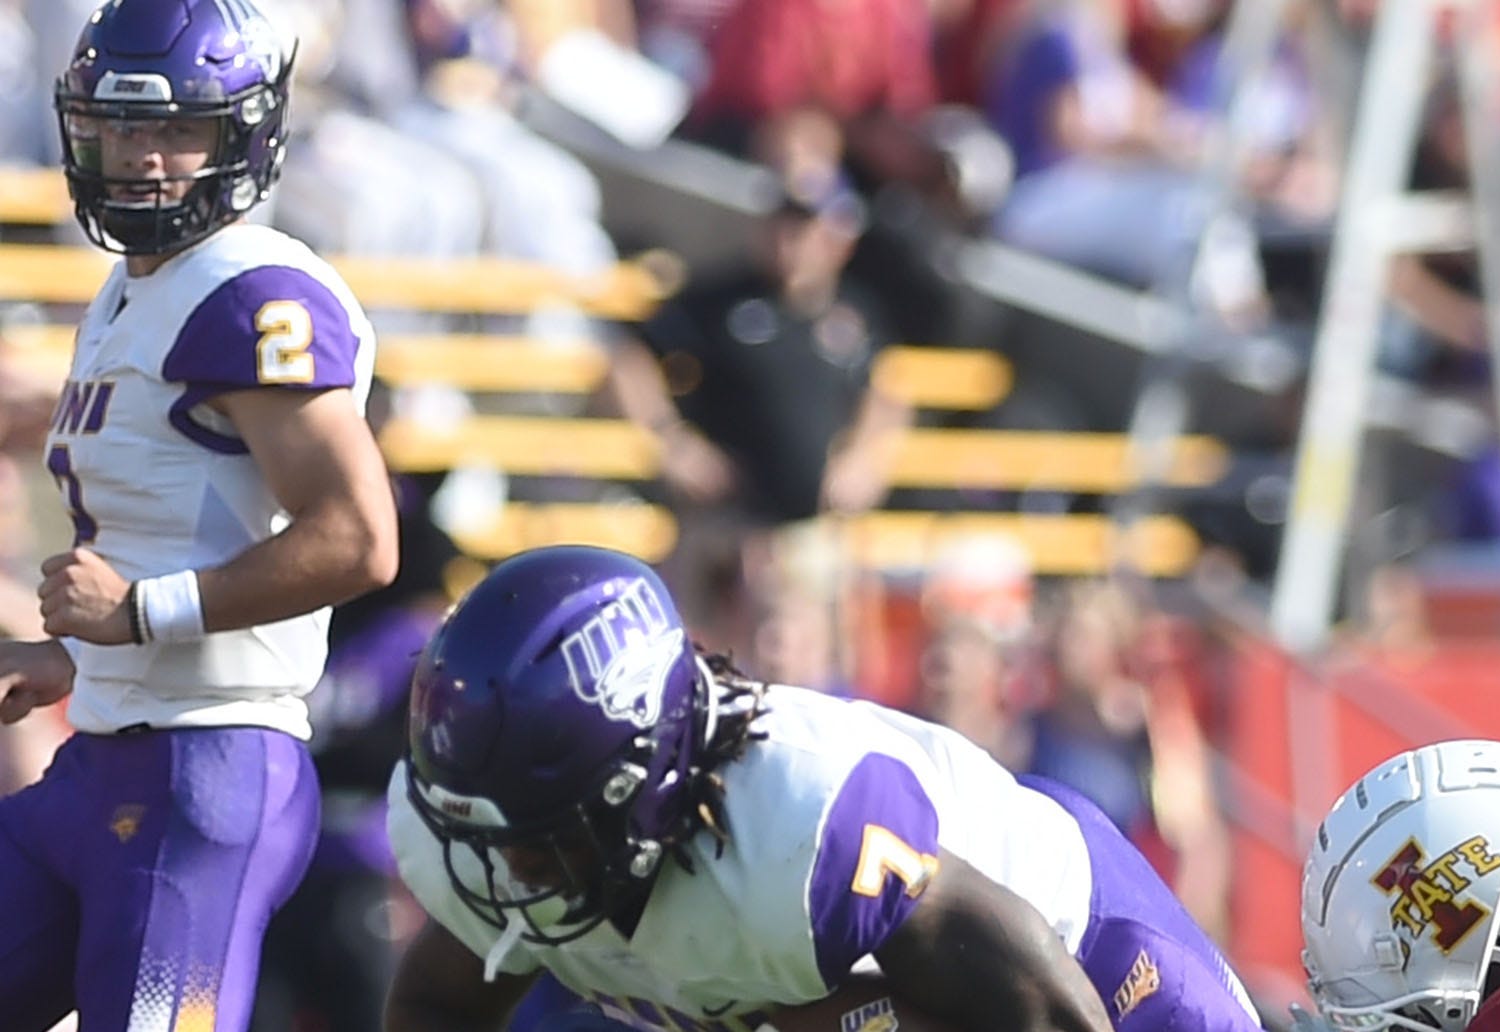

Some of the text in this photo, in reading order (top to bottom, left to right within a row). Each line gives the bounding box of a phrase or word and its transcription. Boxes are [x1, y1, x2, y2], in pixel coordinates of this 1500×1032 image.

[255, 300, 315, 384] 2
[561, 576, 669, 704] UNI
[852, 823, 939, 898] 7
[1113, 948, 1149, 1017] UNI
